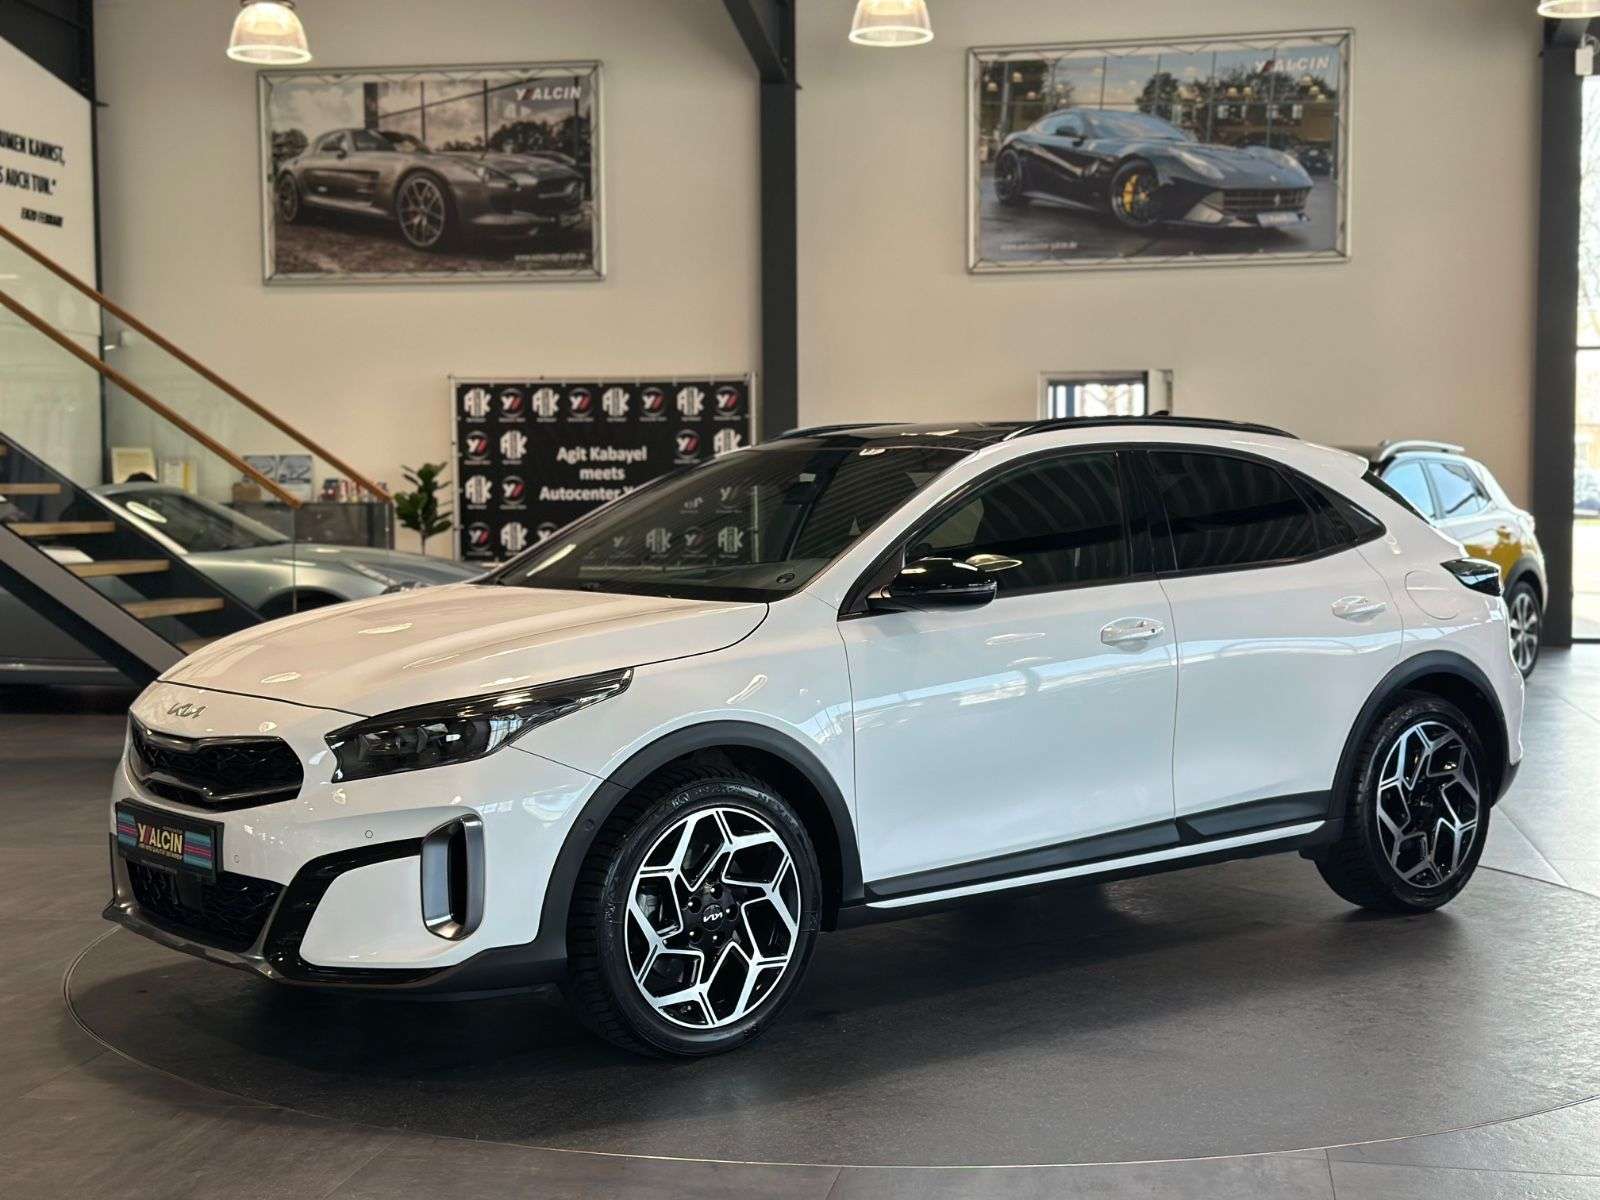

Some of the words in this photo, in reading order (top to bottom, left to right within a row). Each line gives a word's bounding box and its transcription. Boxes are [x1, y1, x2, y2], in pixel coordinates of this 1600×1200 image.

[556, 446, 587, 464] Agit
[590, 445, 648, 464] Kabayel
[579, 467, 626, 480] meets
[539, 486, 621, 501] Autocenter
